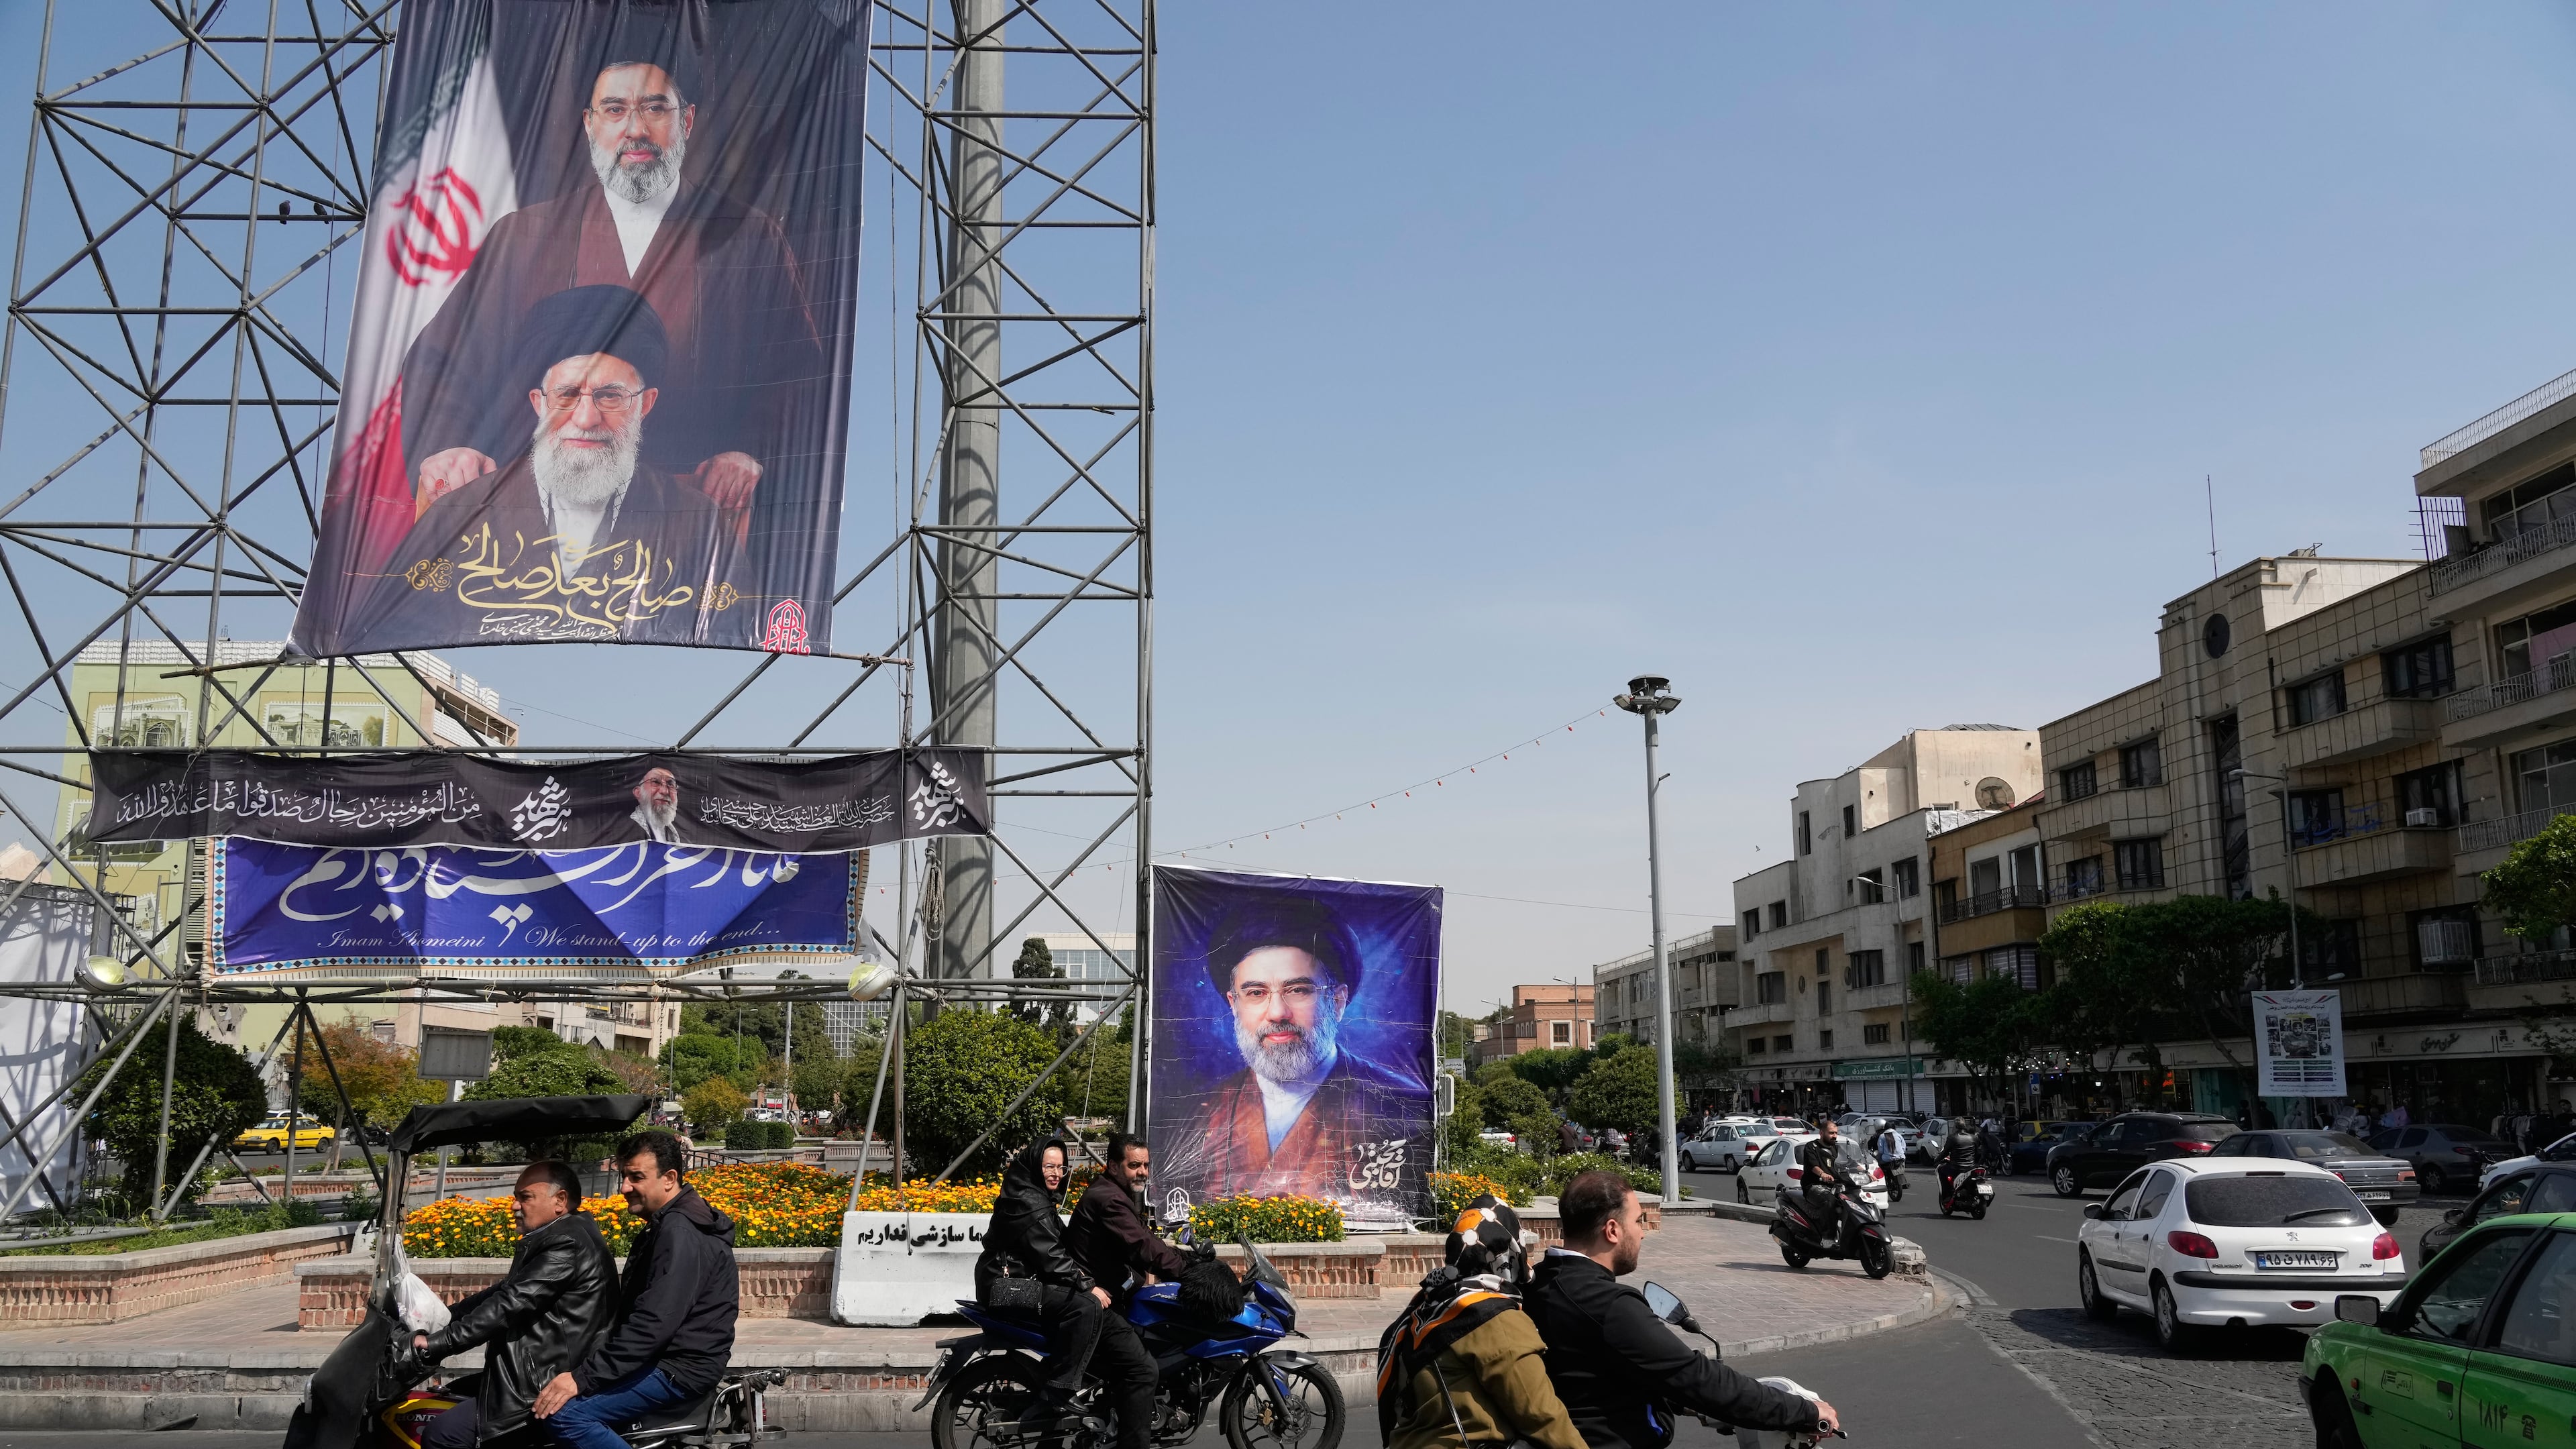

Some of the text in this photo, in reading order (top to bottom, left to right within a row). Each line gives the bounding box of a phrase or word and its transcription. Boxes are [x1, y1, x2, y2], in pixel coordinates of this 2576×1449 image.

[317, 928, 486, 948] Imam Khomeini
[525, 923, 581, 948] We
[570, 931, 658, 955] stand-up
[662, 934, 684, 948] to
[687, 930, 716, 947] the
[1851, 1065, 1895, 1075] بانک کشاورزی
[858, 1224, 906, 1245] نداریم
[910, 1225, 964, 1246] سازشی
[396, 1413, 437, 1422] HOND
